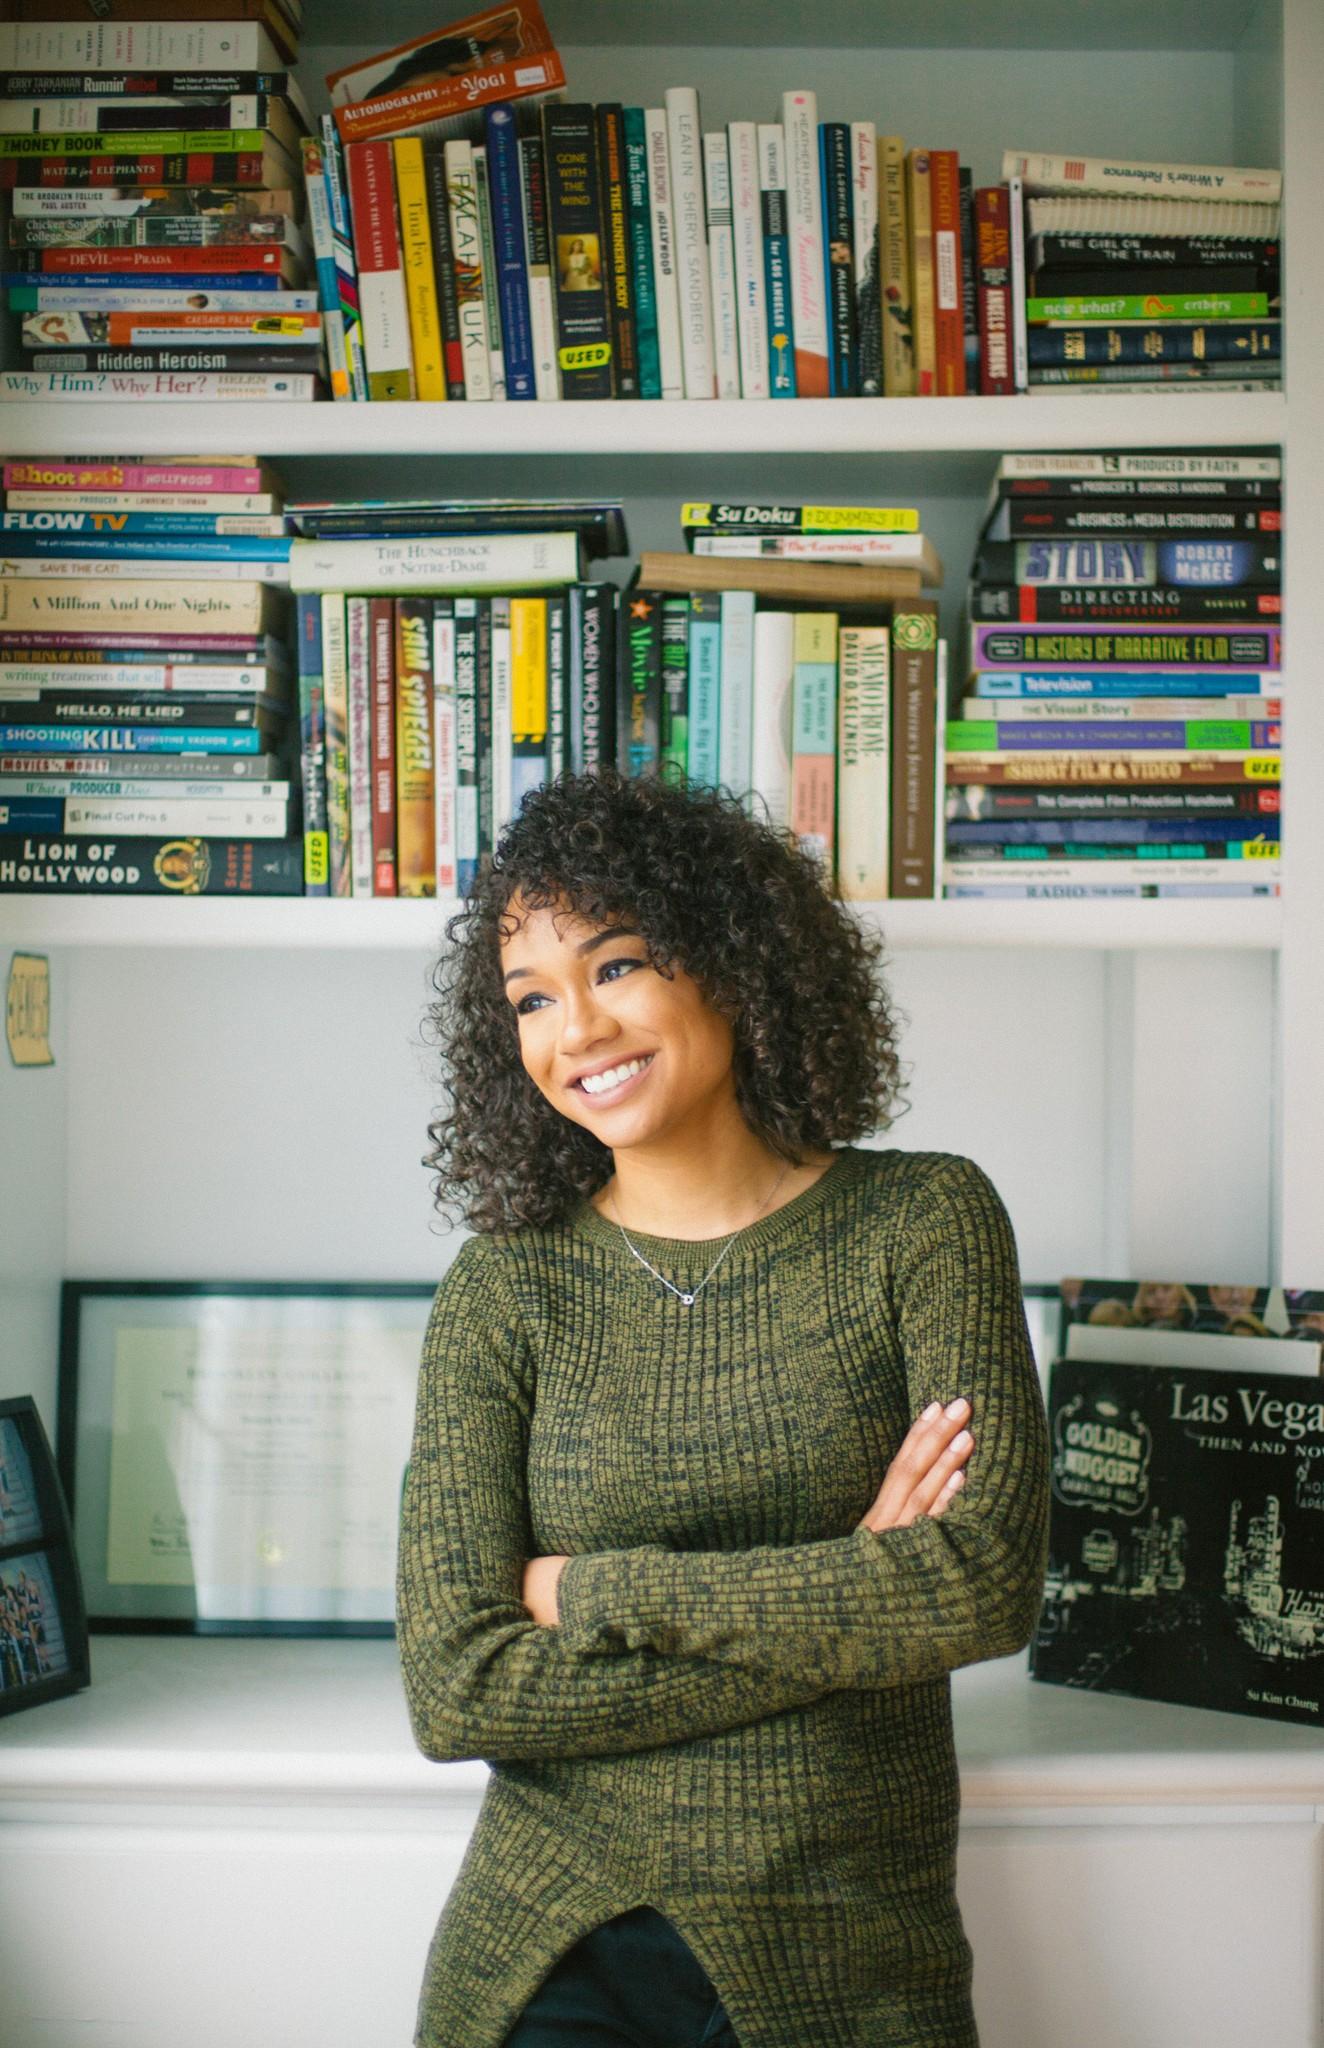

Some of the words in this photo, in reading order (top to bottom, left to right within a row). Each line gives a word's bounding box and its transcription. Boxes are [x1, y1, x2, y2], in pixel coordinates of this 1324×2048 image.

[84, 77, 127, 92] Runnin'
[343, 88, 439, 121] AUTOBIOGRAPHY
[460, 72, 506, 101] YOGI
[11, 138, 59, 152] MONEY
[64, 137, 104, 150] BOOK
[679, 114, 692, 155] LEAN
[800, 112, 812, 169] HEATHER
[556, 153, 588, 164] GONE
[651, 131, 667, 164] CHARLES
[43, 166, 76, 177] WATER
[96, 164, 156, 175] ELEPHANTS
[364, 150, 376, 189] GIANTS
[558, 168, 589, 178] WITH
[682, 161, 694, 176] IN
[887, 163, 900, 184] The
[564, 181, 585, 192] THE
[628, 171, 646, 207] Home
[653, 165, 669, 203] BUKOWSKI
[837, 173, 848, 219] LOOKING
[938, 155, 953, 225] PLEDGED
[369, 192, 378, 203] IN
[560, 195, 591, 206] WIND
[609, 185, 623, 210] THE
[802, 172, 814, 225] HUNTER
[888, 190, 901, 217] Last
[370, 207, 380, 226] THE
[683, 191, 699, 251] SHERYL
[372, 231, 383, 267] EARTH
[611, 212, 627, 274] RUNNER'S
[635, 223, 646, 260] ALISON
[657, 211, 673, 275] HOLLYWOOD
[771, 241, 781, 256] for
[887, 220, 904, 280] Valentine
[979, 222, 995, 265] BROWN
[994, 228, 1009, 257] DAN
[1059, 238, 1085, 249] THE
[1088, 238, 1118, 250] GIRL
[1121, 239, 1141, 249] ON
[70, 251, 113, 266] DEVIL
[1104, 249, 1131, 260] THE
[1135, 249, 1176, 261] TRAIN
[771, 258, 783, 278] LOS
[615, 275, 629, 308] BODY
[687, 257, 704, 345] SANDBERG
[836, 269, 848, 320] MICHAEL
[772, 281, 785, 327] ANGELES
[986, 289, 1006, 330] ANGELS
[1079, 299, 1126, 314] what?
[97, 352, 153, 371] Hidden
[158, 351, 228, 370] Heroism
[566, 350, 604, 364] USED
[988, 332, 1008, 379] DEMONS
[6, 376, 43, 396] Why
[49, 373, 107, 391] Him?
[111, 377, 151, 398] Why
[155, 374, 208, 393] Her?
[11, 464, 77, 486] shoot
[1126, 457, 1187, 471] PRODUCED
[1189, 458, 1205, 471] BY
[1207, 458, 1240, 472] FAITH
[145, 474, 213, 487] HOLLYWOOD
[1082, 482, 1135, 494] PRODUCER'S
[1137, 482, 1180, 494] BUSINESS
[1182, 482, 1227, 494] HANDBOOK
[79, 495, 118, 505] PRODUCER
[3, 512, 85, 529] FLOW
[90, 513, 129, 530] TV
[716, 505, 740, 522] Su
[743, 507, 797, 523] Doku
[814, 511, 887, 526] DUMMIES
[1076, 513, 1126, 527] BUSINESS
[1134, 513, 1165, 527] MEDIA
[1167, 513, 1235, 528] DISTRIBUTION
[375, 546, 402, 559] THE
[407, 544, 491, 559] HUNCHBACK
[1026, 541, 1146, 583] STORY
[1176, 545, 1234, 561] ROBERT
[40, 564, 69, 574] SAVE
[70, 564, 92, 574] THE
[95, 564, 120, 574] CAT!
[400, 560, 488, 575] NOTRE-DAME
[47, 596, 101, 610] Million
[109, 596, 139, 610] And
[144, 599, 176, 611] One
[182, 597, 232, 614] Nights
[1060, 591, 1181, 605] DIRECTING
[583, 607, 600, 669] WOMEN
[662, 617, 687, 641] THE
[376, 618, 390, 681] FILMMAKERS
[401, 616, 432, 669] SAM
[456, 631, 475, 655] THE
[699, 637, 712, 672] Small
[1024, 637, 1034, 660] A
[1036, 637, 1093, 661] HISTORY
[1095, 637, 1113, 661] OF
[1115, 637, 1189, 661] NARRATIVE
[1194, 637, 1230, 662] FILM
[631, 626, 655, 692] Movie
[662, 644, 687, 667] BIZ
[844, 632, 859, 679] DAVID
[5, 669, 48, 683] writing
[117, 668, 141, 682] that
[143, 669, 162, 683] sell
[456, 656, 475, 696] SHORT
[858, 642, 886, 702] MEMO
[907, 658, 922, 685] THE
[377, 683, 390, 704] AND
[583, 671, 600, 713] WHO
[1025, 677, 1093, 692] Television
[56, 705, 115, 718] HELLO,
[117, 705, 141, 717] HE
[145, 705, 185, 718] LIED
[1045, 703, 1089, 715] Visual
[1092, 703, 1131, 717] Story
[377, 705, 390, 759] FINANCING
[401, 674, 432, 772] SPIEGEL
[456, 698, 475, 771] SCREENPLAY
[583, 714, 600, 745] RUN
[844, 694, 858, 767] SELZNICK
[6, 729, 82, 742] SHOOTING
[82, 728, 137, 751] KILL
[138, 735, 184, 746] CHRISTINE
[188, 736, 227, 746] VACHON
[1, 758, 50, 772] MOVIES
[65, 759, 109, 773] MONEY
[124, 762, 160, 772] DAVID
[1006, 762, 1068, 780] SHORT
[1070, 762, 1110, 780] FILM
[1131, 762, 1182, 779] VIDEO
[70, 783, 122, 795] PRODUCER
[907, 753, 922, 813] JOURNEY
[1037, 795, 1056, 808] The
[1058, 796, 1101, 810] Complete
[1106, 795, 1127, 808] Film
[1130, 795, 1183, 808] Production
[1186, 795, 1234, 808] Handbook
[85, 811, 113, 822] Final
[115, 811, 136, 822] Cut
[138, 811, 158, 822] Pro
[24, 839, 77, 861] LION
[88, 844, 116, 861] OF
[311, 838, 322, 877] USED
[1, 861, 140, 884] HOLLYWOOD
[1170, 1383, 1229, 1424] Las
[1066, 1422, 1142, 1458] GOLDEN
[1197, 1435, 1243, 1451] THEN
[1248, 1441, 1287, 1456] AND
[1064, 1448, 1141, 1485] NUGGET
[1262, 1691, 1283, 1706] Kim
[1285, 1694, 1319, 1713] Chung
